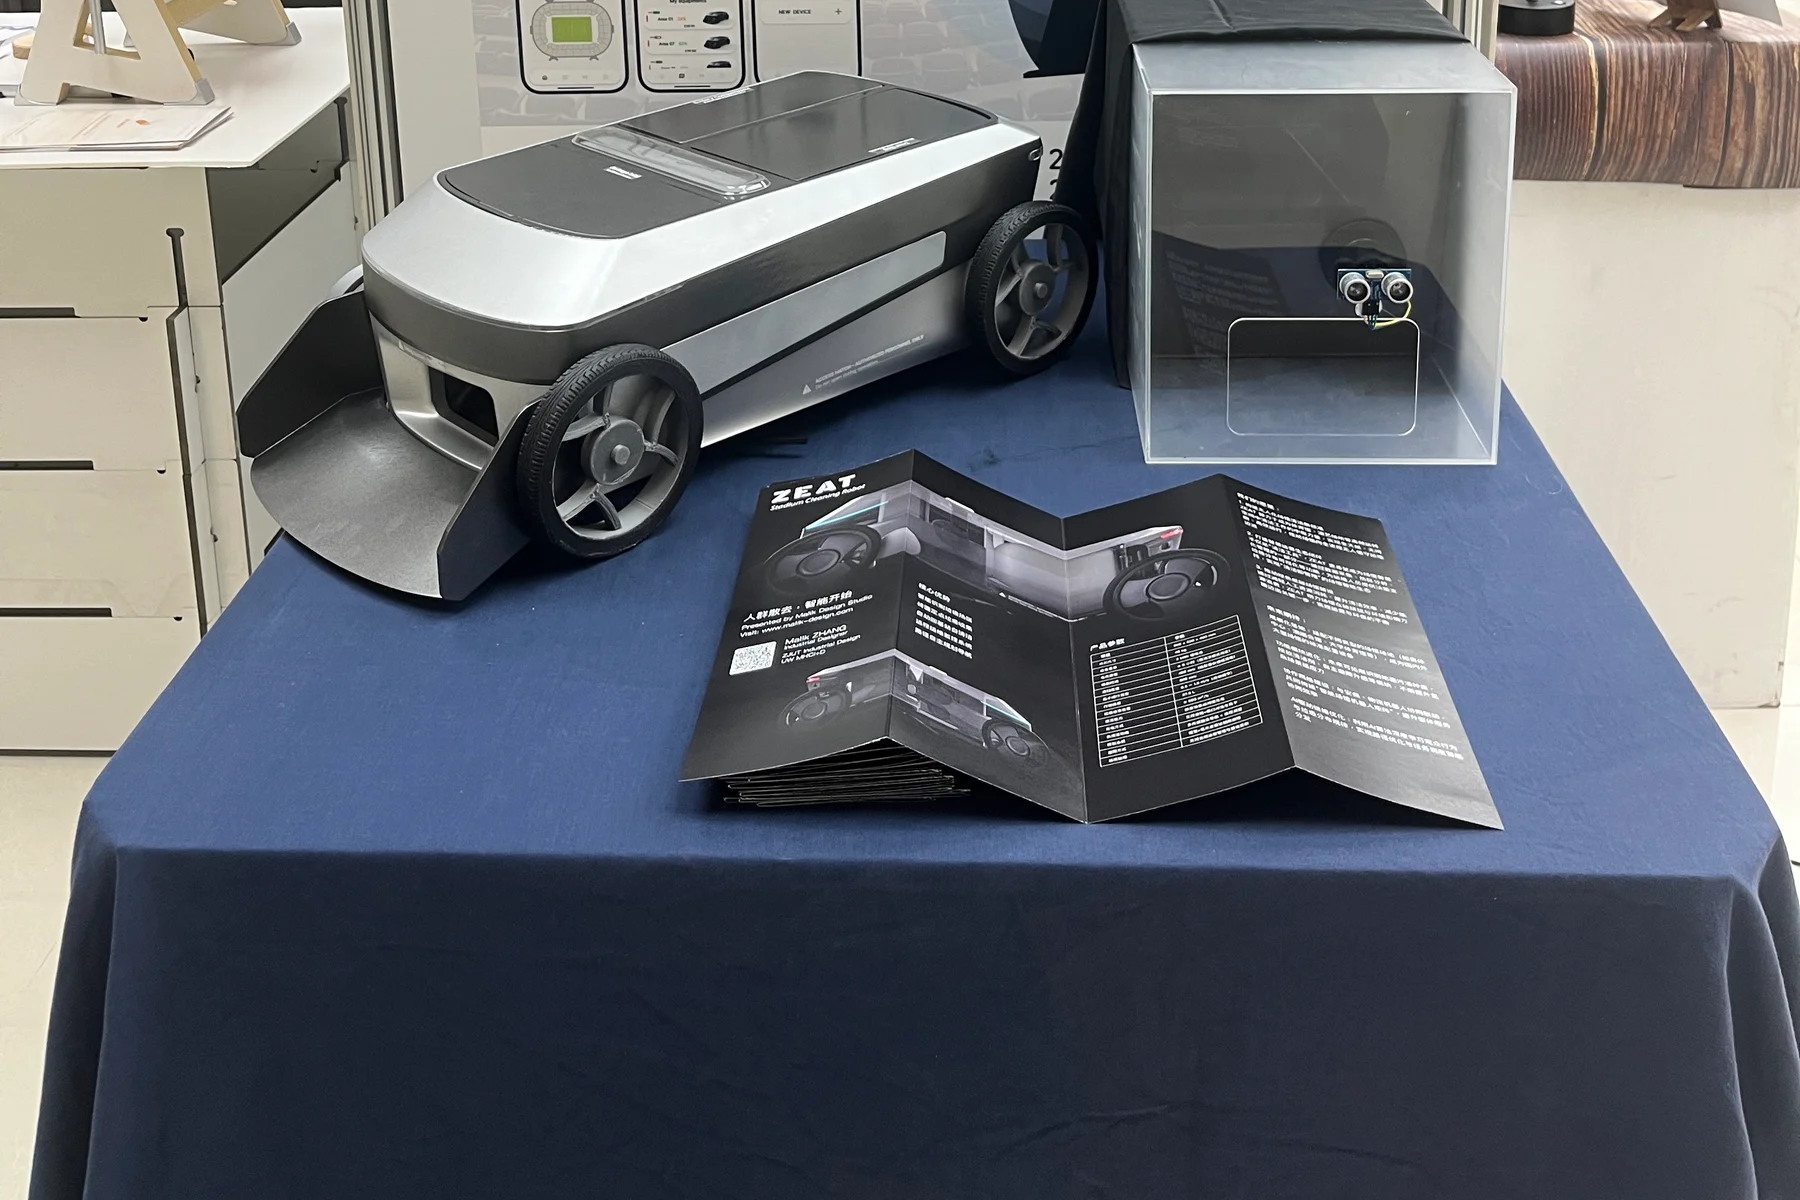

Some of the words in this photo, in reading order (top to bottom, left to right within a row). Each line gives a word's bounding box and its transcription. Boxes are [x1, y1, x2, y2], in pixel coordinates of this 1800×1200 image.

[769, 499, 804, 511] Stadium
[805, 491, 841, 504] Cleaning
[841, 484, 866, 495] Robot
[771, 474, 856, 504] ZEAT
[741, 617, 781, 631] Presented
[795, 610, 816, 619] Malik
[818, 603, 846, 613] Design
[783, 639, 816, 650] Industrial
[784, 635, 810, 645] Malik
[812, 624, 847, 639] ZHANG
[803, 641, 836, 653] Industrial
[836, 634, 861, 646] Design
[1089, 638, 1125, 652] 产品参数
